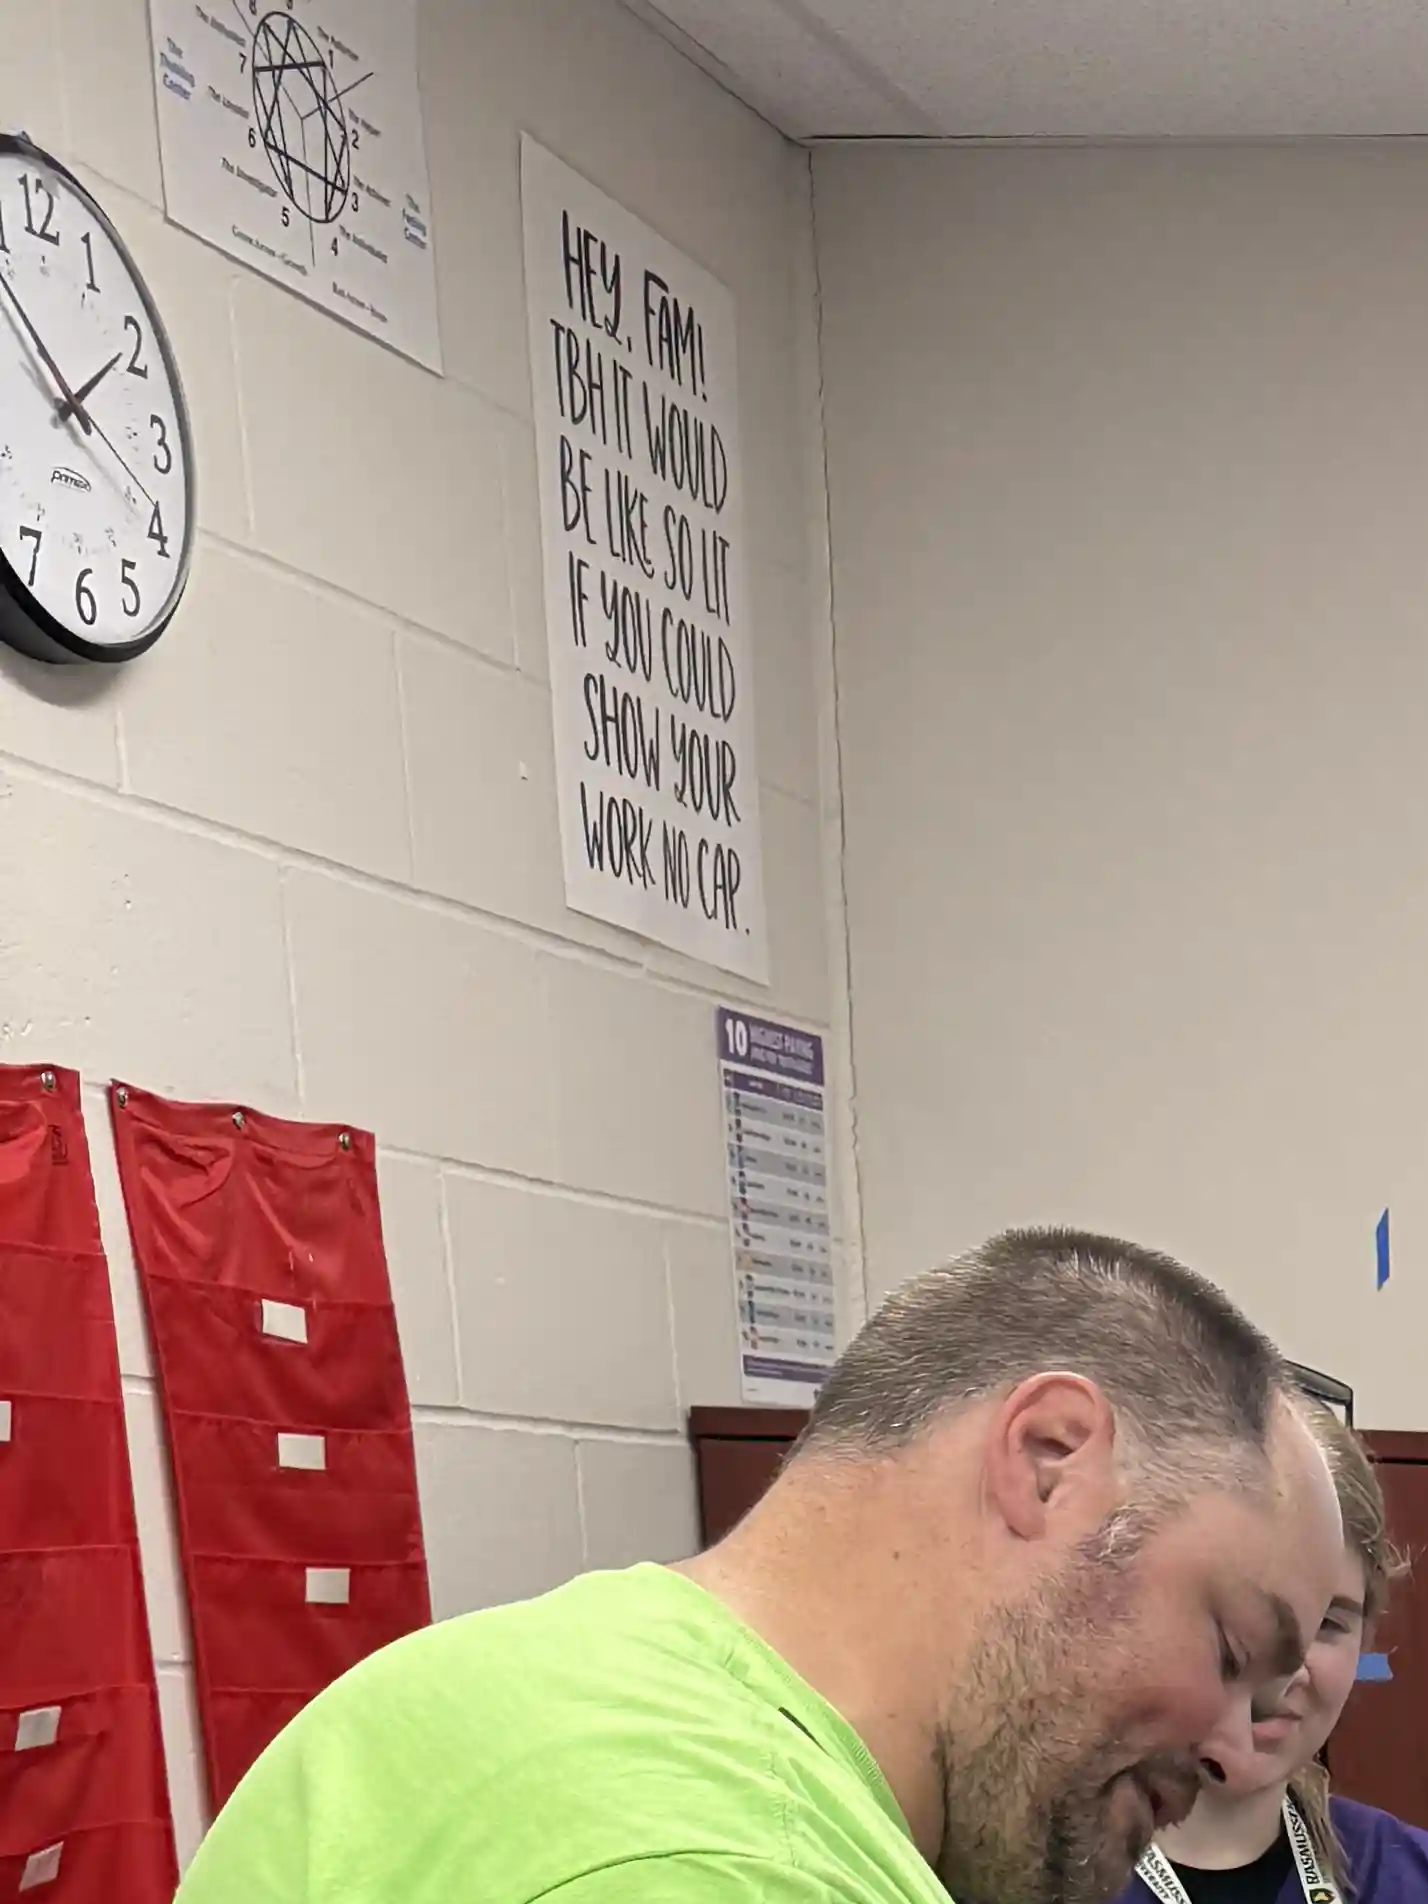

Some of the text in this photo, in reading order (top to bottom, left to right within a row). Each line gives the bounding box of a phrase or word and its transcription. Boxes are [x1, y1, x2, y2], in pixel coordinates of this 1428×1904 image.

[238, 52, 248, 73] 7
[328, 49, 335, 69] 1
[248, 127, 256, 149] 6
[351, 129, 359, 149] 2
[18, 173, 60, 246] 12
[280, 207, 290, 227] 5
[351, 192, 359, 212] 3
[80, 231, 101, 293] 1
[330, 237, 338, 256] 4
[562, 209, 632, 353] HEY,
[644, 269, 708, 403] FAM!
[123, 315, 148, 378] 2
[150, 413, 172, 474] 3
[550, 318, 728, 515] TBH IT WOULD
[19, 525, 42, 587] 7
[147, 500, 170, 559] 4
[560, 434, 729, 626] BE LIKE SO LIT
[75, 566, 97, 626] 6
[120, 557, 141, 618] 5
[568, 550, 736, 722] IF YOU COULD
[583, 673, 741, 827] SHOW YOUR
[580, 781, 750, 936] WORK NO CAP.
[725, 1018, 748, 1057] 10
